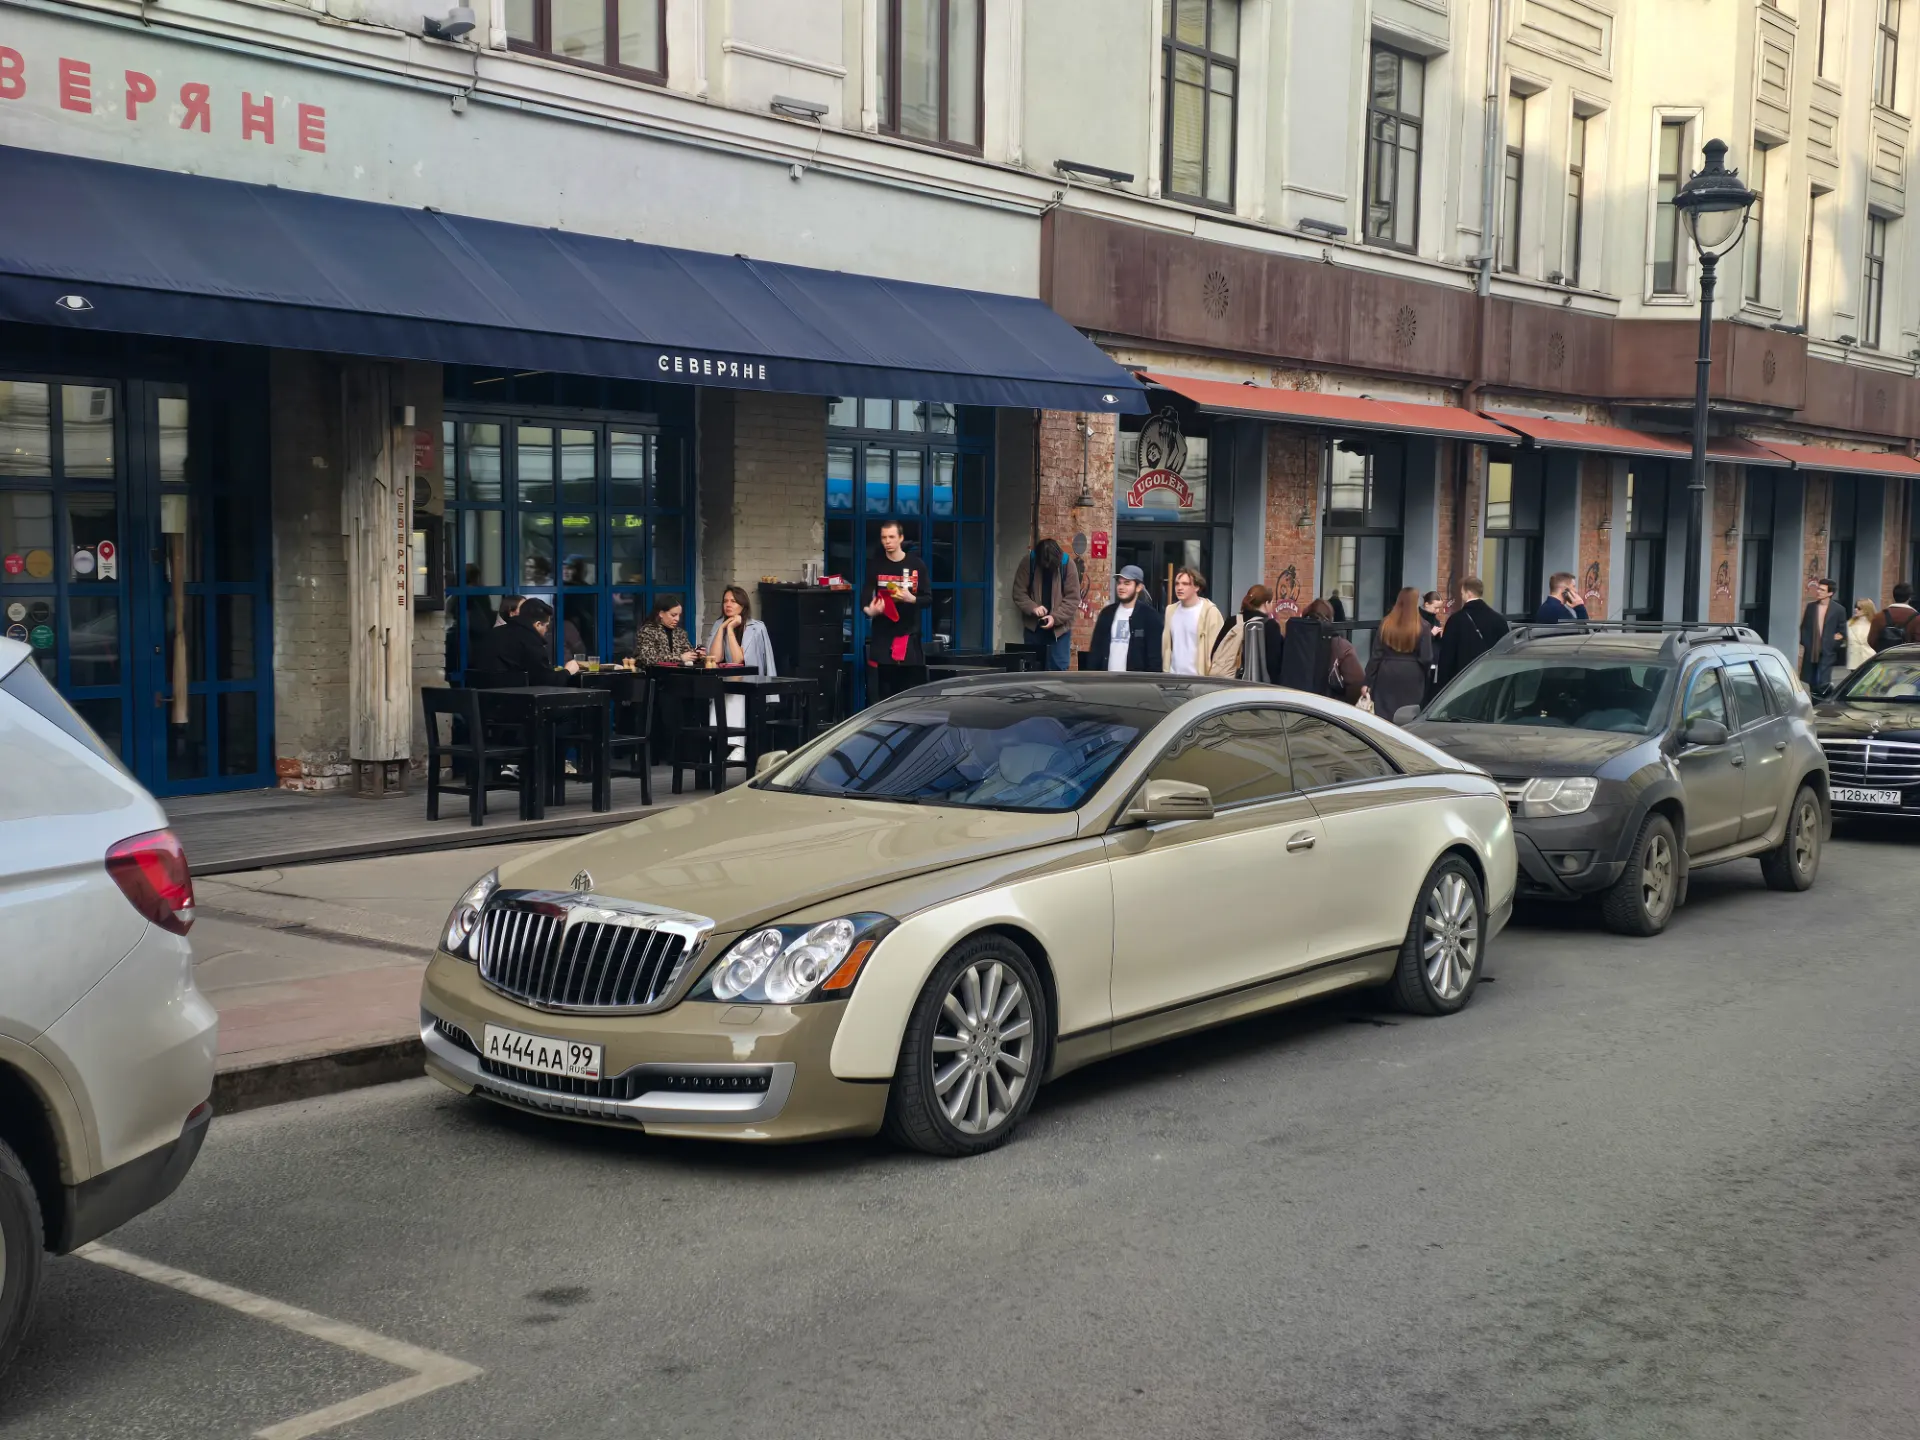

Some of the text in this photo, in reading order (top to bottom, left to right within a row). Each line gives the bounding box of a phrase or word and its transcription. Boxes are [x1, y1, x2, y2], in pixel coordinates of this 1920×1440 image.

[0, 45, 327, 154] ВЕРЯНЕ
[657, 354, 767, 380] СЕВЕРЯНЕ
[396, 487, 405, 606] СЕВЕРЯНЕ
[1879, 790, 1898, 801] 797
[490, 1033, 593, 1071] А444АА 99
[568, 1065, 586, 1075] RUS
